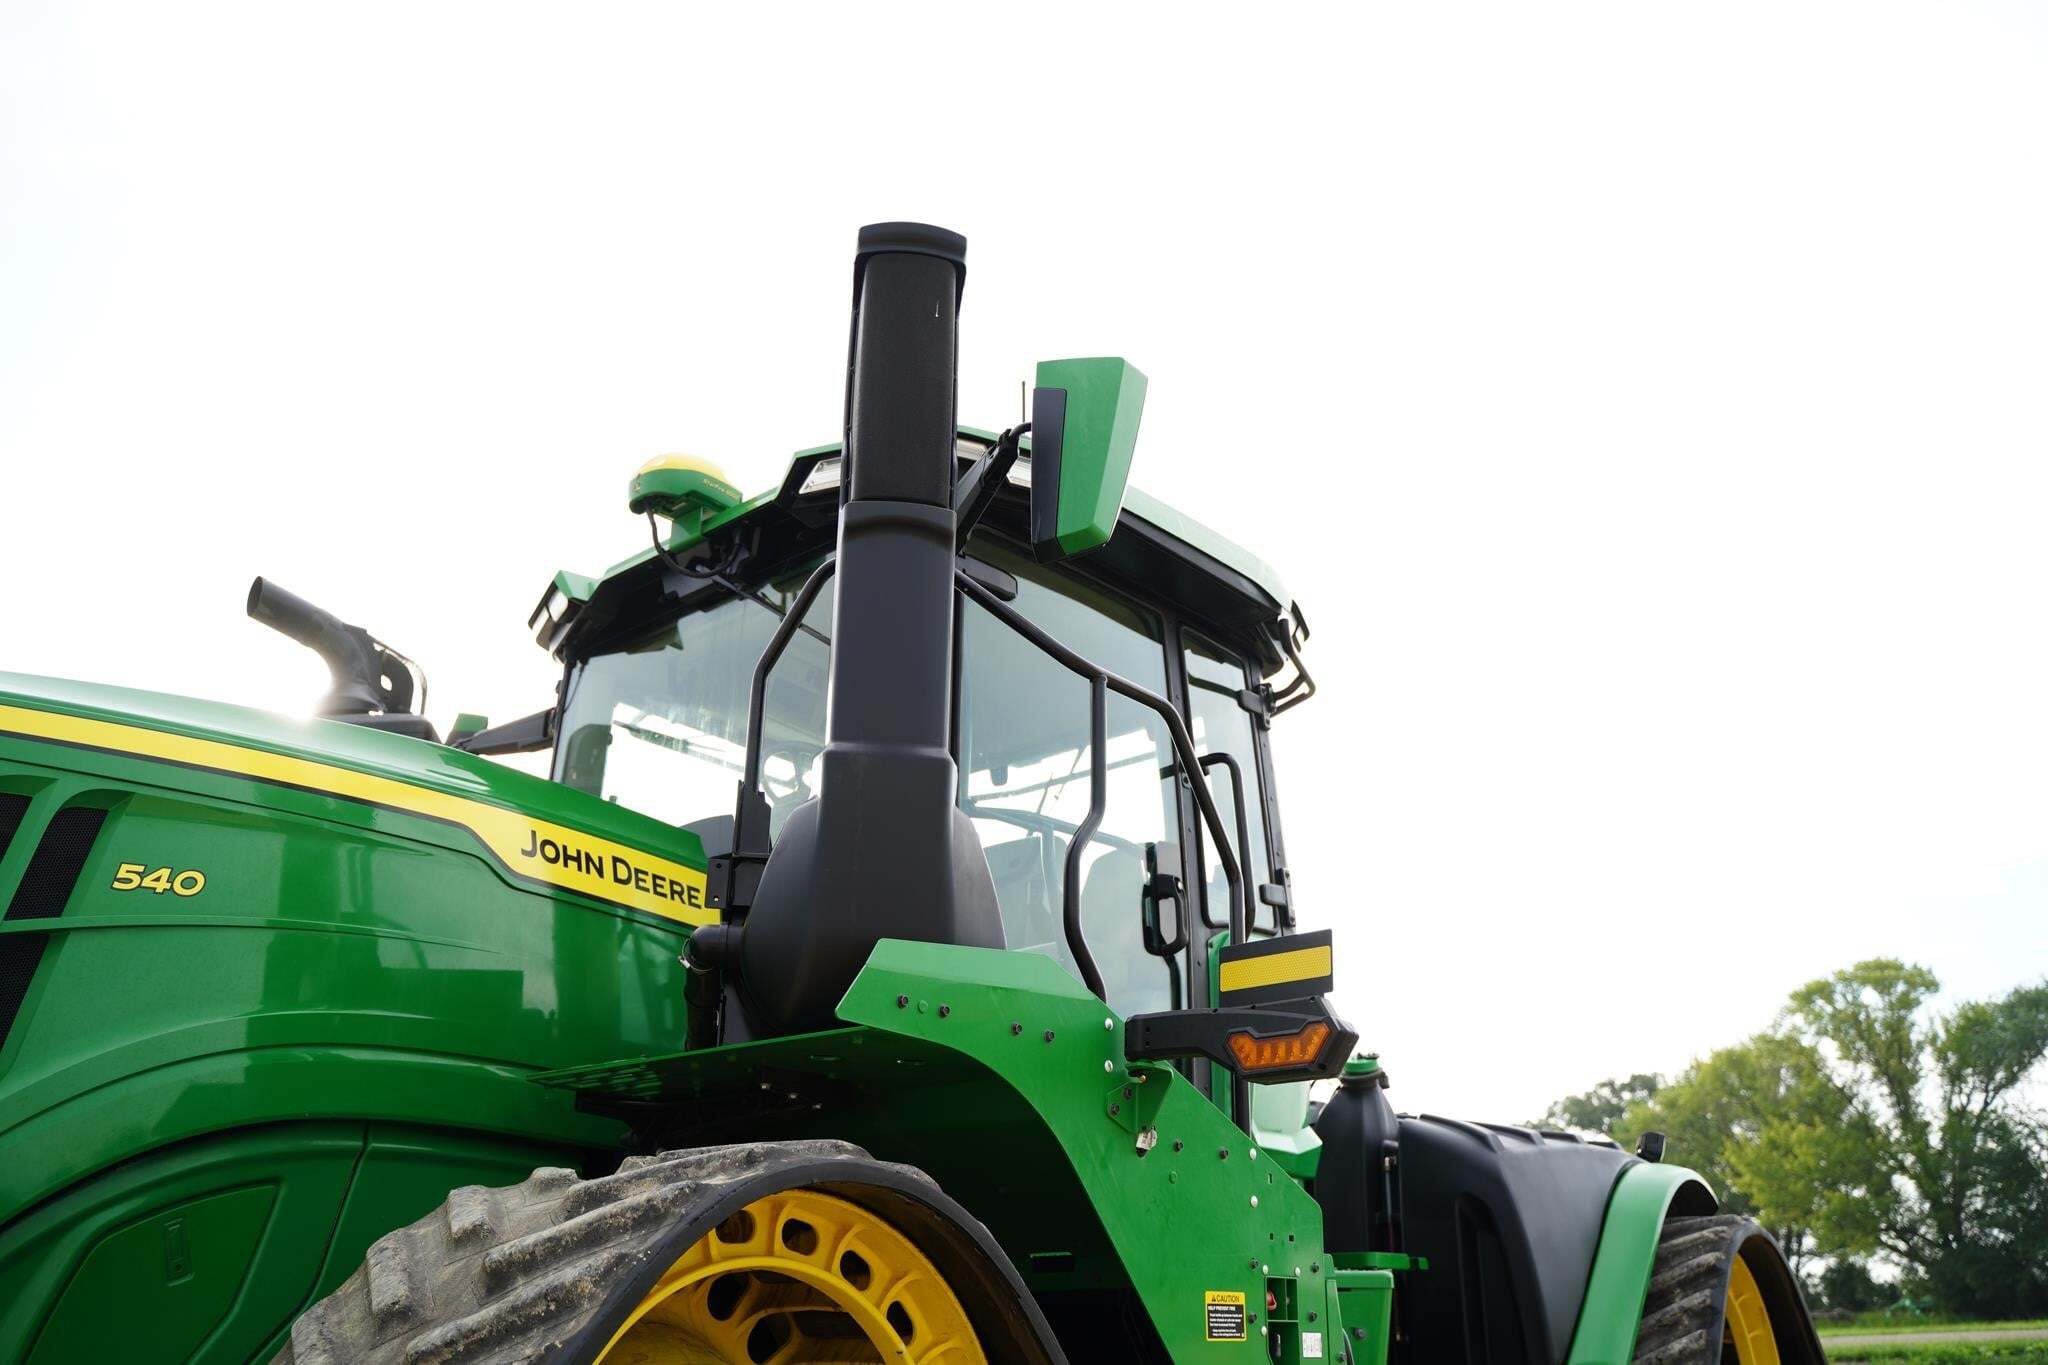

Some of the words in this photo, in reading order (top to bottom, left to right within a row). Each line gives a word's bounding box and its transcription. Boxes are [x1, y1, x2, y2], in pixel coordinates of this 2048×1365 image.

[110, 861, 206, 897] 540
[520, 829, 605, 879] JOHN
[611, 855, 702, 910] DEERE
[1216, 1294, 1240, 1303] CAUTION
